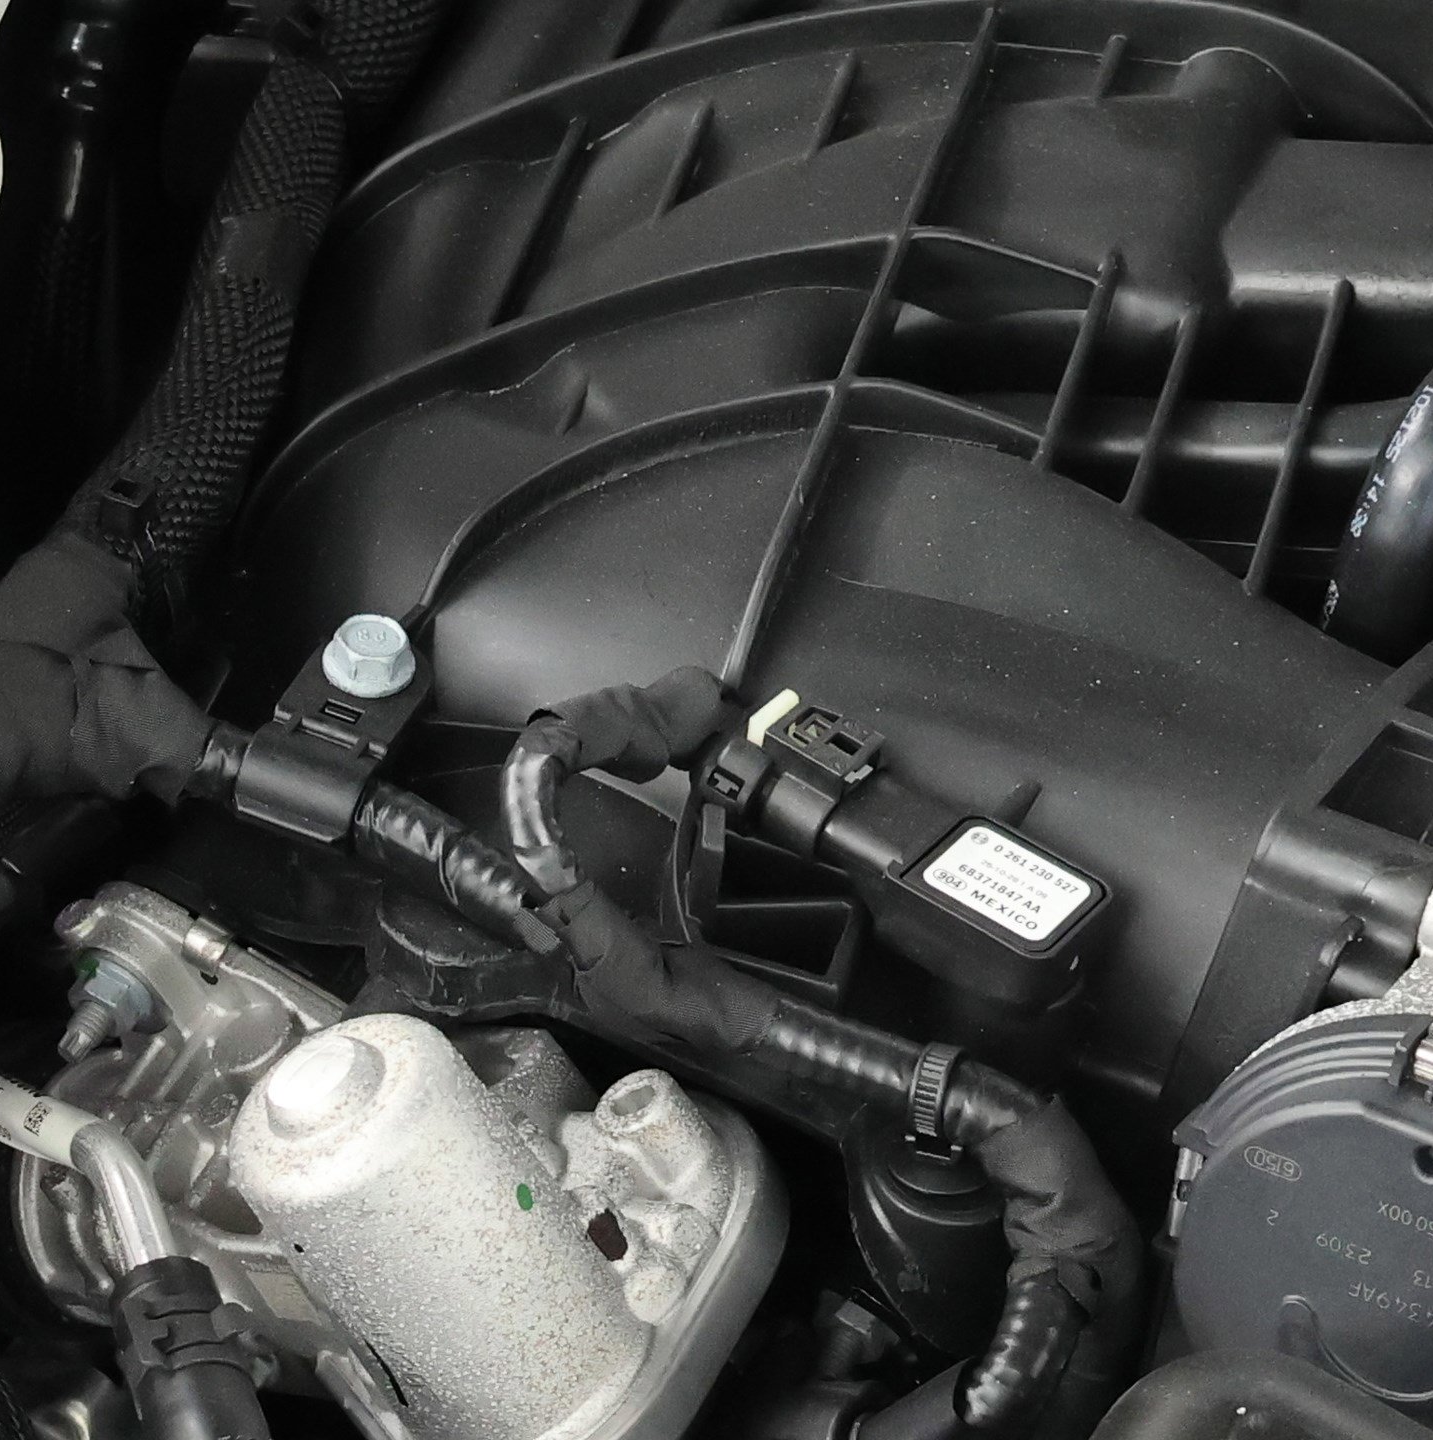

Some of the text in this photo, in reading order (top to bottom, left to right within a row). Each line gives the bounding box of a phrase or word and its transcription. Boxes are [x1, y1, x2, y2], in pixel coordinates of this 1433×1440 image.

[1004, 850, 1027, 867] 261
[1029, 864, 1054, 881] 230
[1053, 878, 1080, 894] 527
[937, 871, 1038, 930] 904 MEXICO
